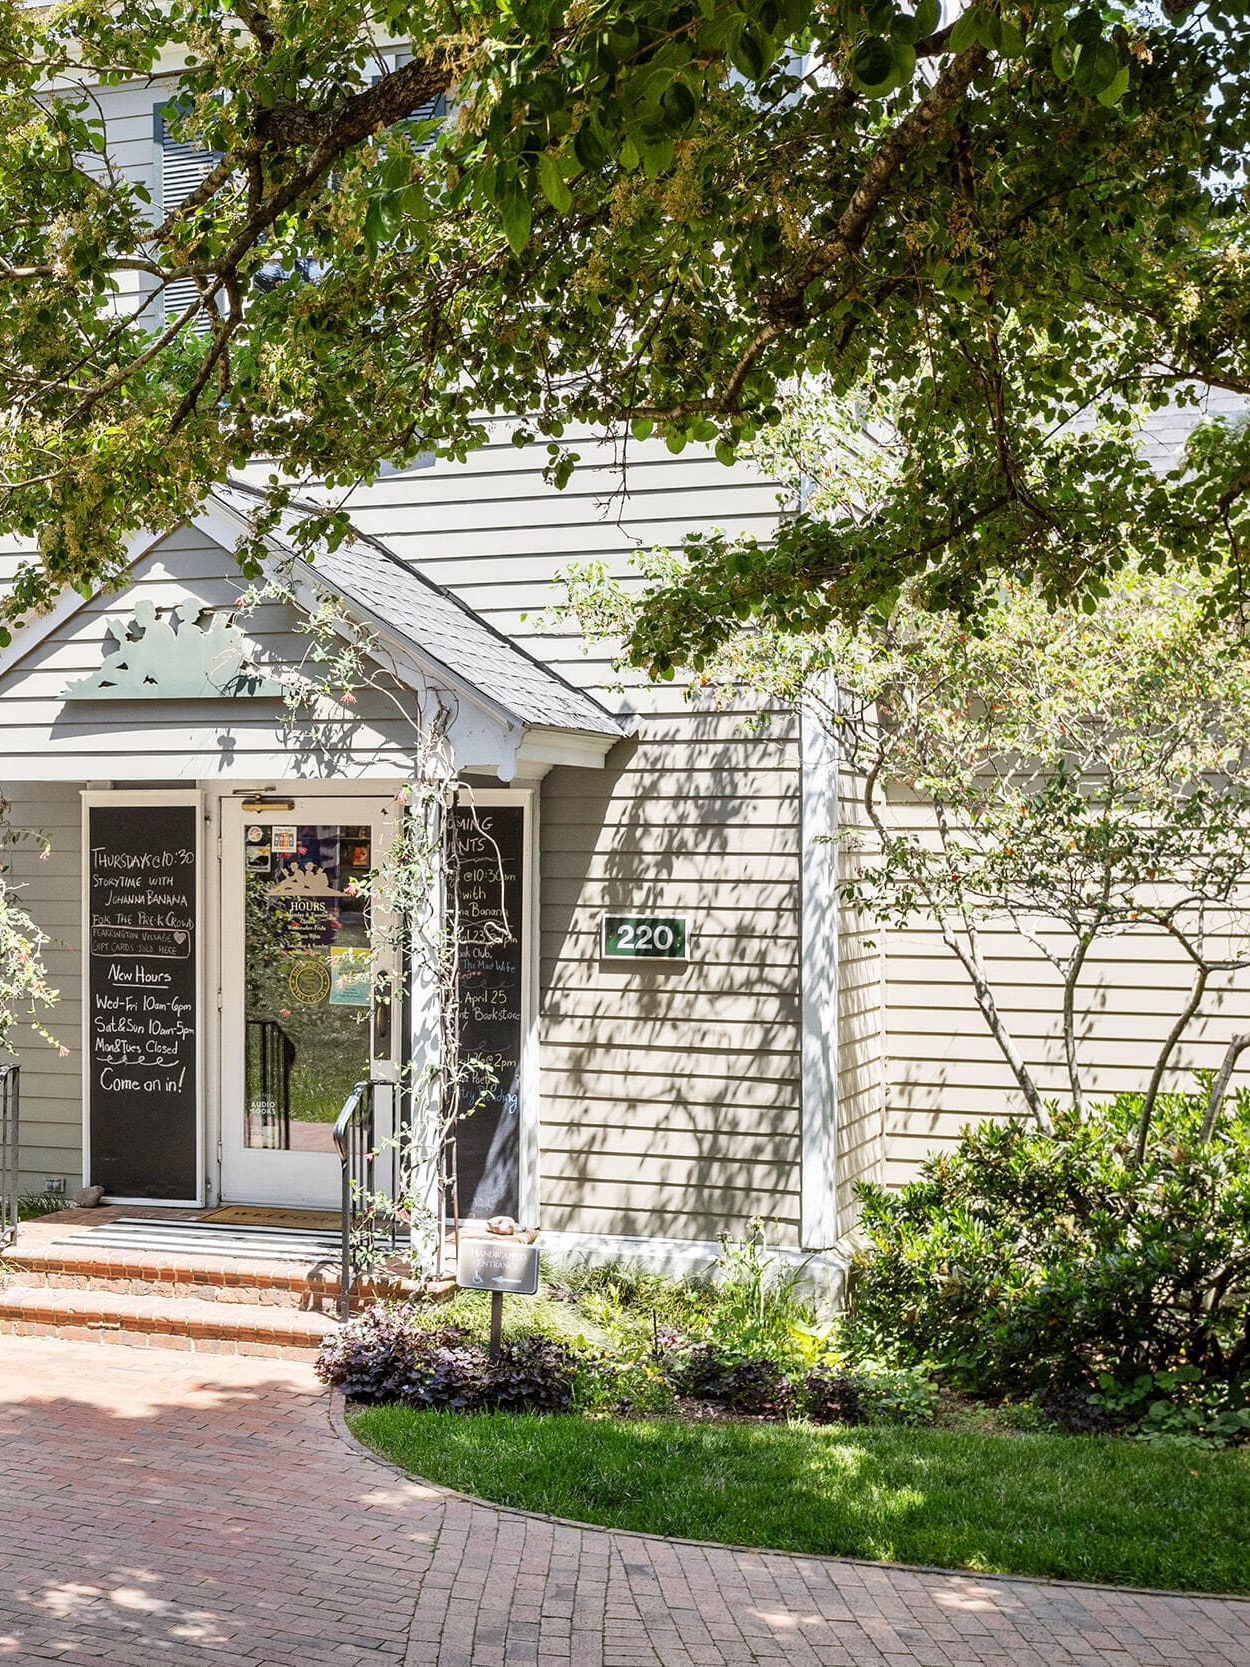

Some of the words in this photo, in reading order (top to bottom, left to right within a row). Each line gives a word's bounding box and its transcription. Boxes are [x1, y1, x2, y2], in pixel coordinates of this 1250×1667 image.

[93, 873, 142, 888] STORYTIME
[149, 876, 174, 886] WITH
[146, 889, 188, 907] BANANA
[462, 885, 487, 900] with
[291, 901, 326, 911] HOURS
[93, 914, 111, 926] FOR
[116, 913, 132, 925] THE
[617, 925, 674, 950] 220
[107, 963, 133, 981] New
[135, 964, 172, 983] Hours
[96, 993, 139, 1011] Wed-Fri
[143, 995, 192, 1017] 10am-6pm
[465, 989, 488, 1008] April
[490, 989, 508, 1004] 25
[472, 1006, 521, 1021] Bookstore
[145, 1040, 179, 1054] Closed
[100, 1067, 141, 1092] Come
[143, 1078, 161, 1091] on
[165, 1066, 187, 1093] in!
